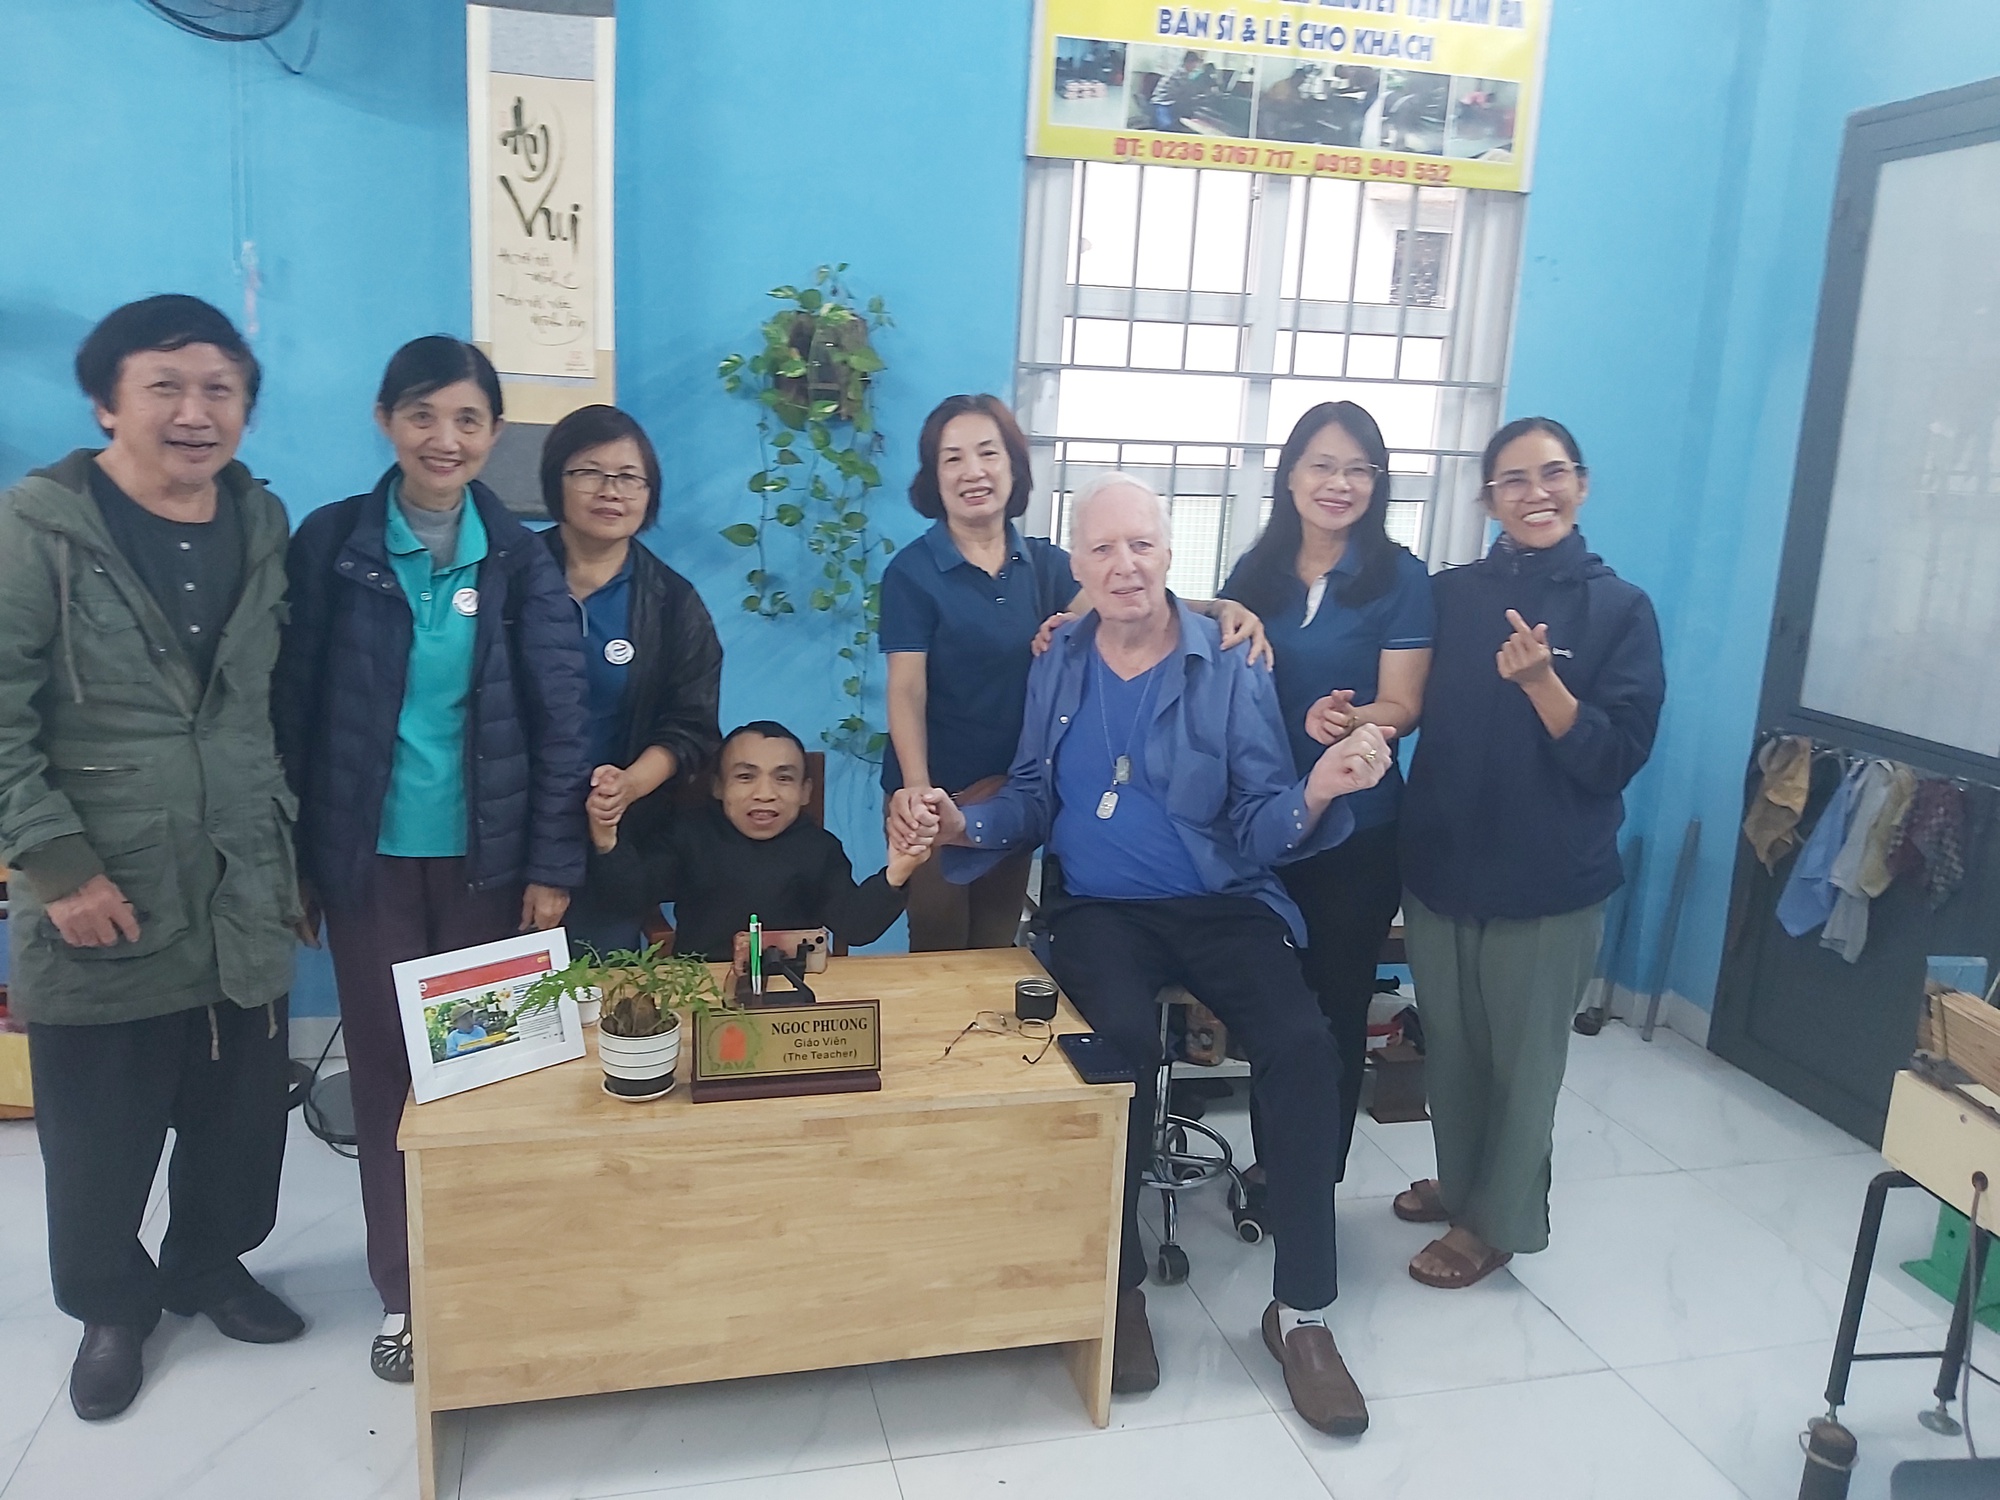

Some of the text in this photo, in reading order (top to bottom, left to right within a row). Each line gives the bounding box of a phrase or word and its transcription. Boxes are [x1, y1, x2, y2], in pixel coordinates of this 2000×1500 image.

[1242, 17, 1256, 42] &
[1298, 22, 1346, 51] CHO
[1152, 140, 1204, 161] 0236
[1212, 144, 1259, 165] 3767
[1265, 149, 1294, 169] 717
[1315, 153, 1362, 175] 0913
[1369, 158, 1407, 178] 949
[1415, 162, 1451, 182] 552
[794, 1036, 847, 1048] Giáo Viên
[783, 1049, 858, 1063] (The Teacher)
[710, 1061, 756, 1072] DAVA
